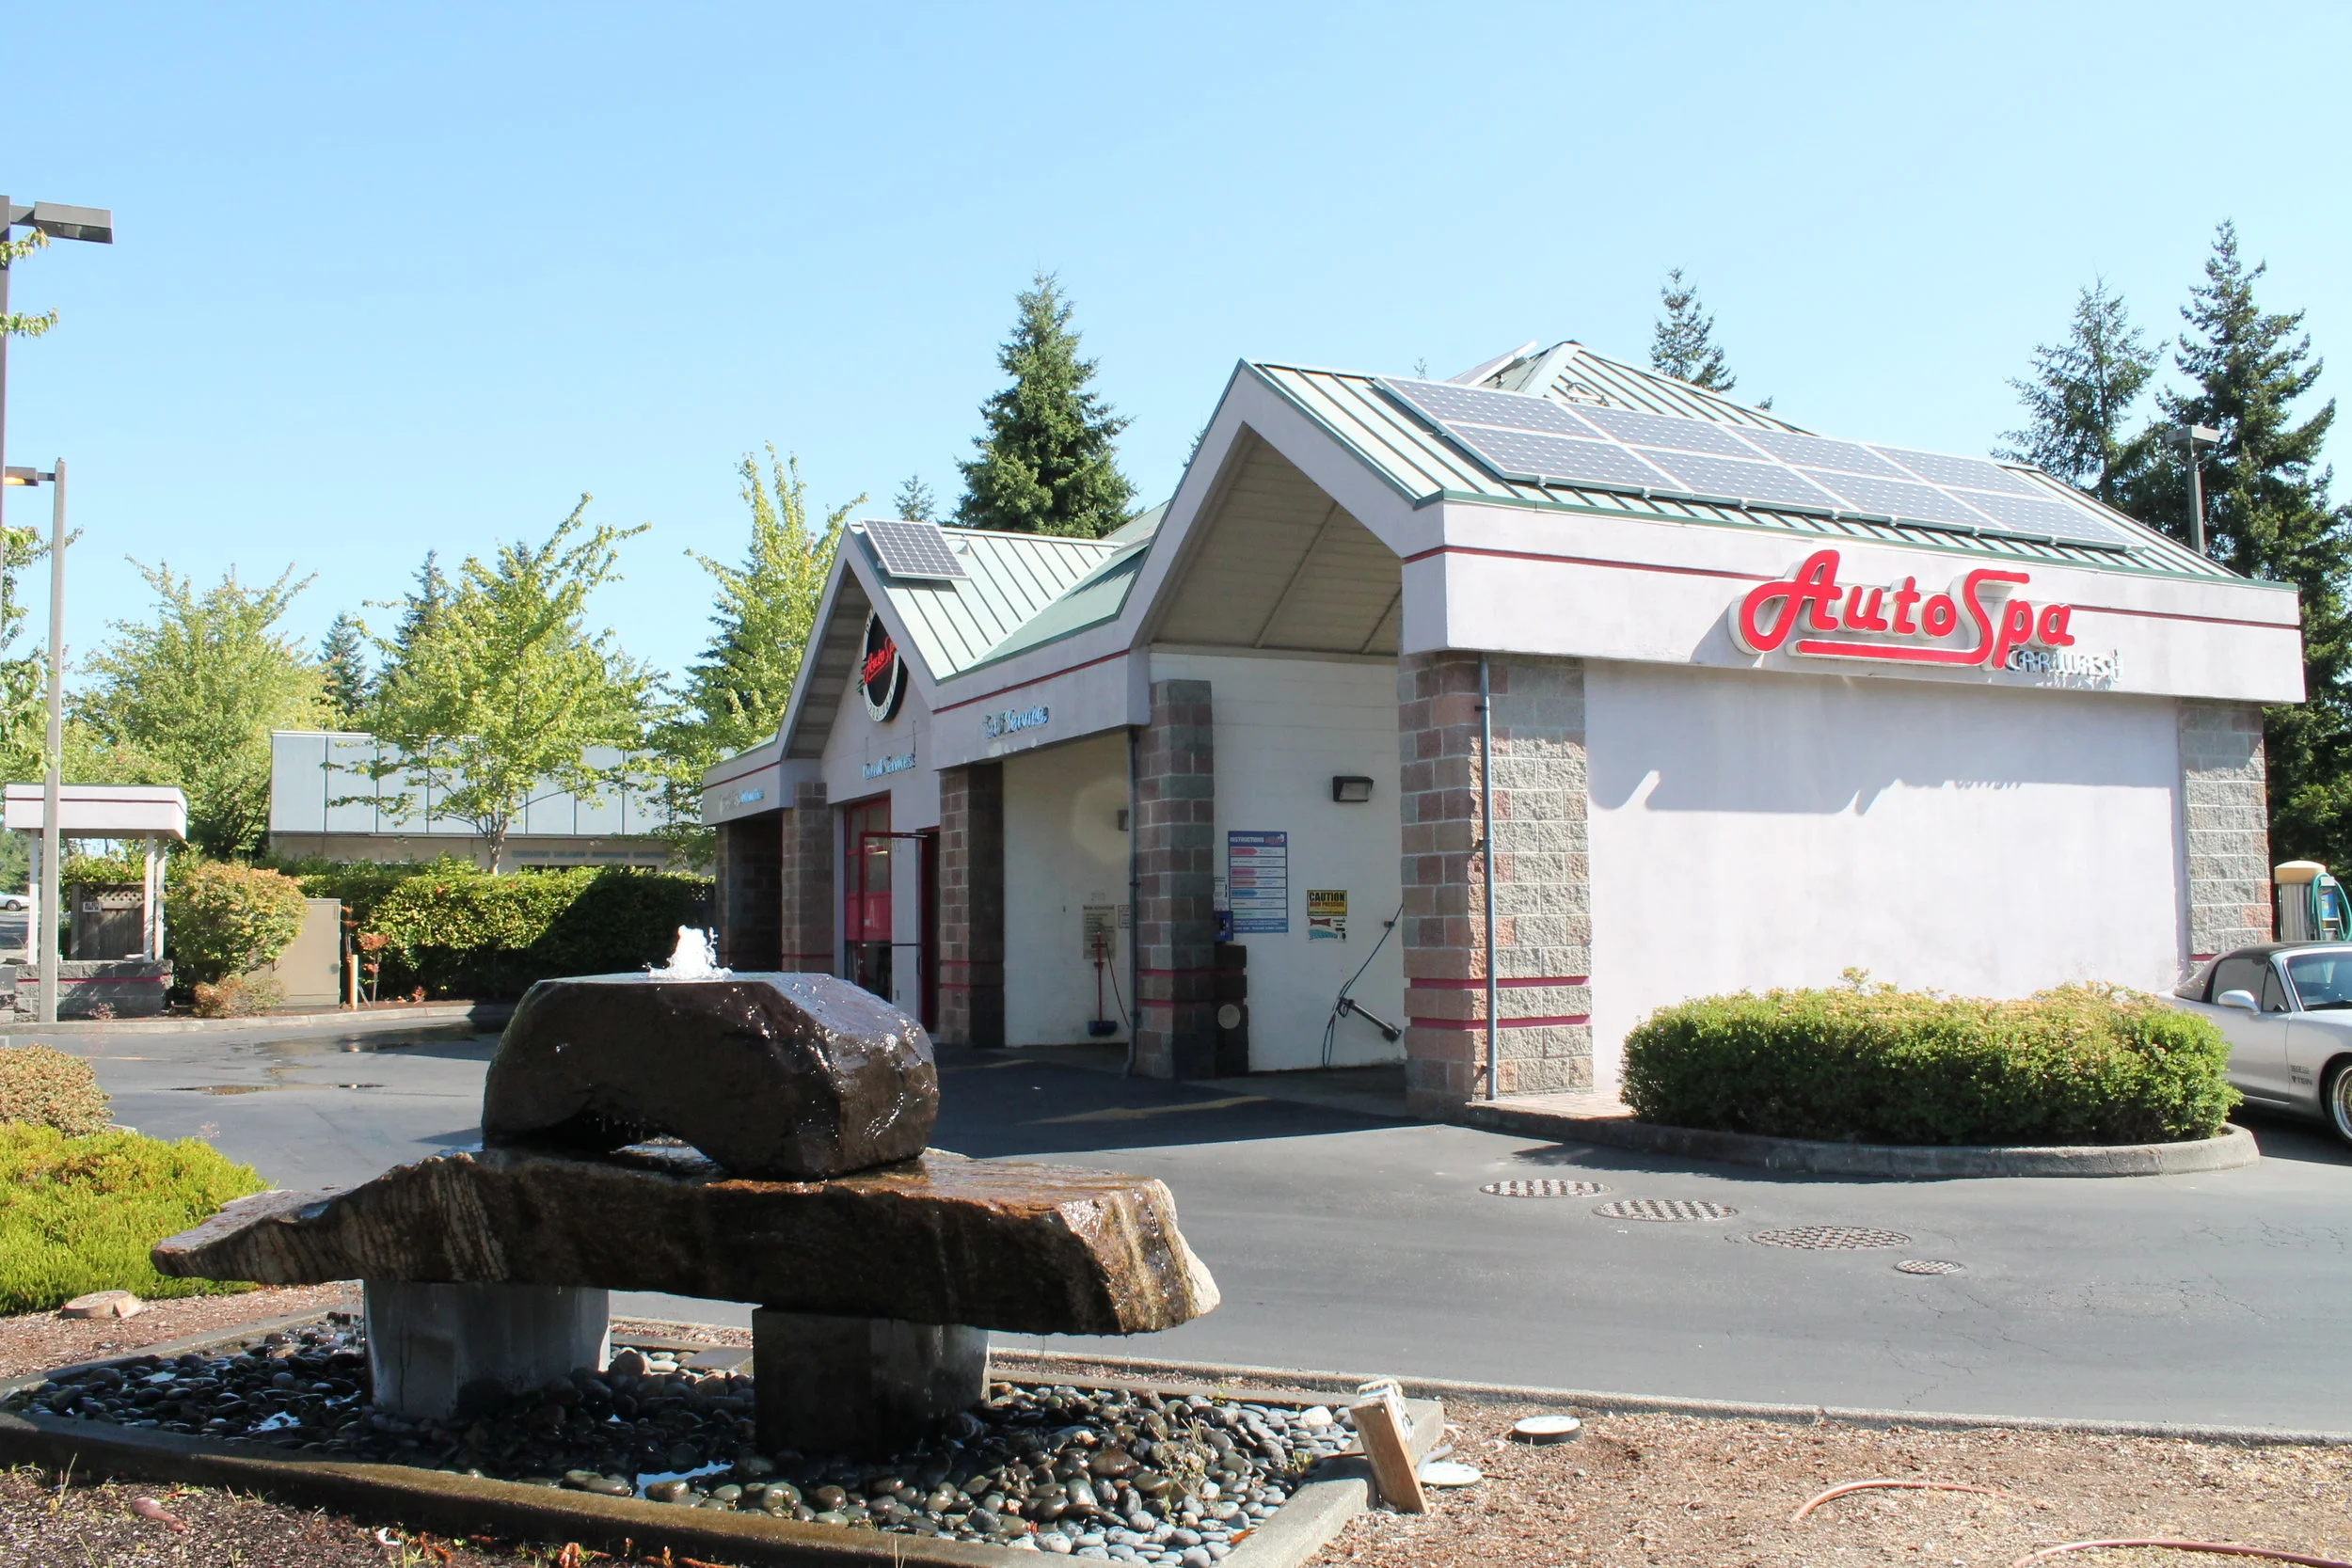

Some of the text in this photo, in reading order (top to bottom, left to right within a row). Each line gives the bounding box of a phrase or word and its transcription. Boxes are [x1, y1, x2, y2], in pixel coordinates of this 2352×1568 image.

[2006, 648, 2123, 682] CAR WASH
[1309, 892, 1345, 901] CAUTION
